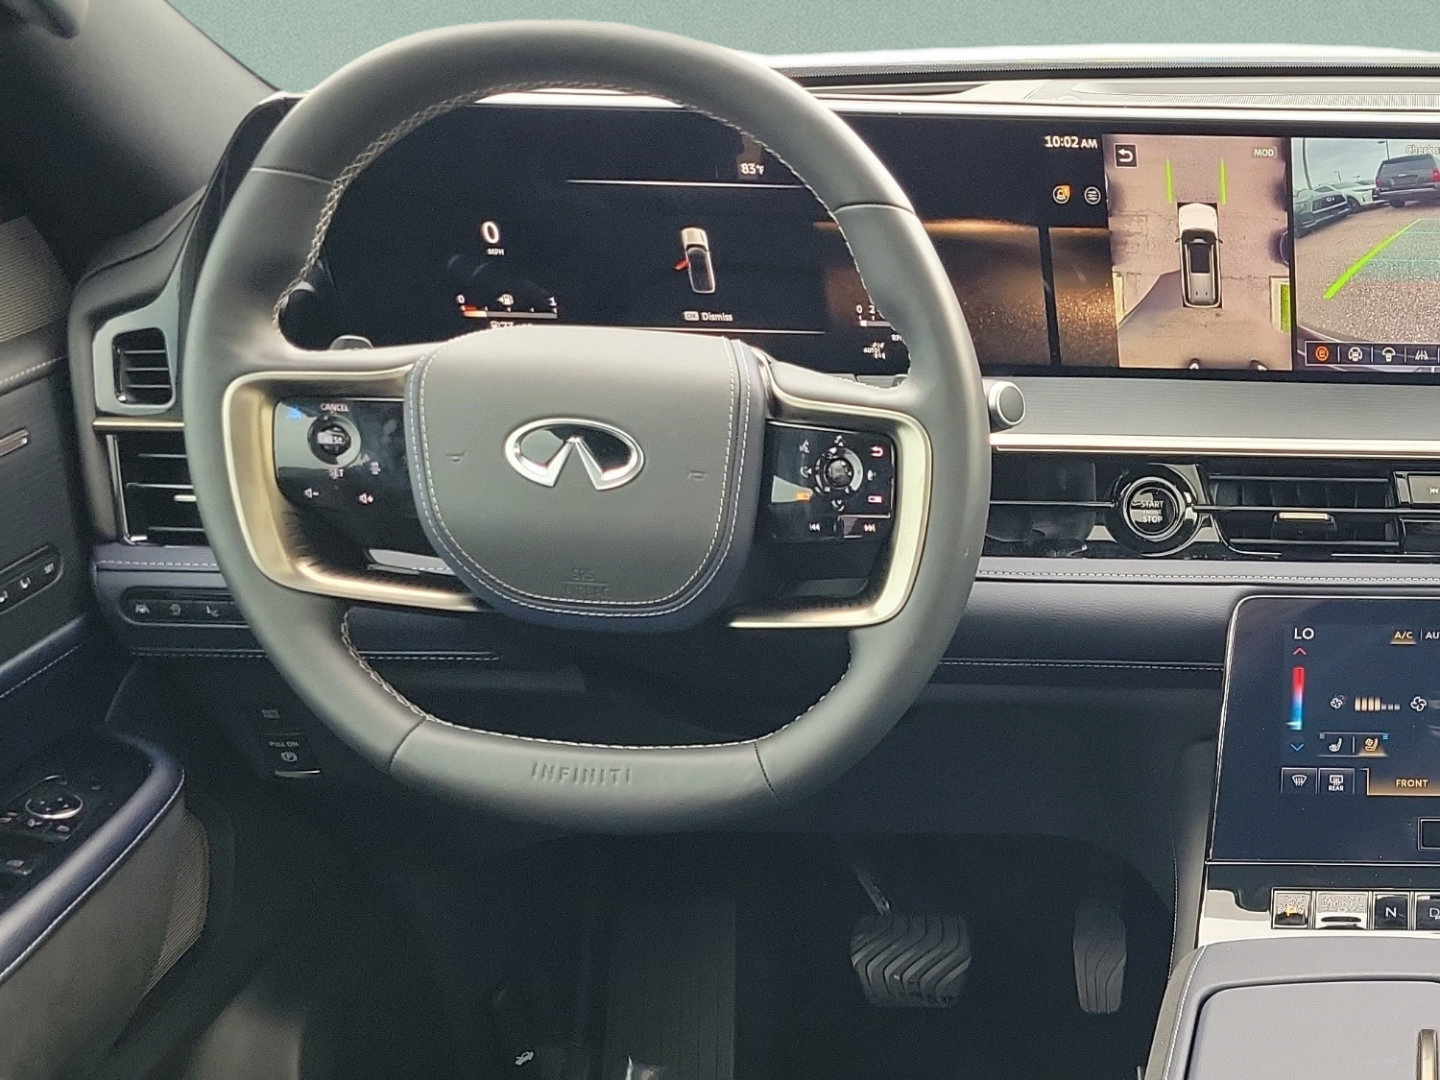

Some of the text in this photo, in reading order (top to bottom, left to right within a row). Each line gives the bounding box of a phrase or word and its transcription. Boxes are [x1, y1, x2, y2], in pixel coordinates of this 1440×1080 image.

[1044, 136, 1098, 149] 10:02 AM
[1253, 149, 1275, 157] MOD
[1405, 144, 1433, 154] Check
[740, 163, 764, 175] 83°F
[481, 221, 500, 244] 0
[456, 294, 466, 304] 0
[547, 296, 557, 306] 1
[856, 304, 863, 314] 0
[701, 312, 734, 322] Dismiss
[320, 403, 350, 412] CANCEL
[1140, 500, 1164, 508] START
[1142, 515, 1163, 523] STOP
[1293, 627, 1315, 640] LO
[1394, 631, 1413, 640] A/C
[531, 761, 632, 785] INFINITI
[1395, 779, 1429, 788] FRONT
[1385, 907, 1397, 918] N
